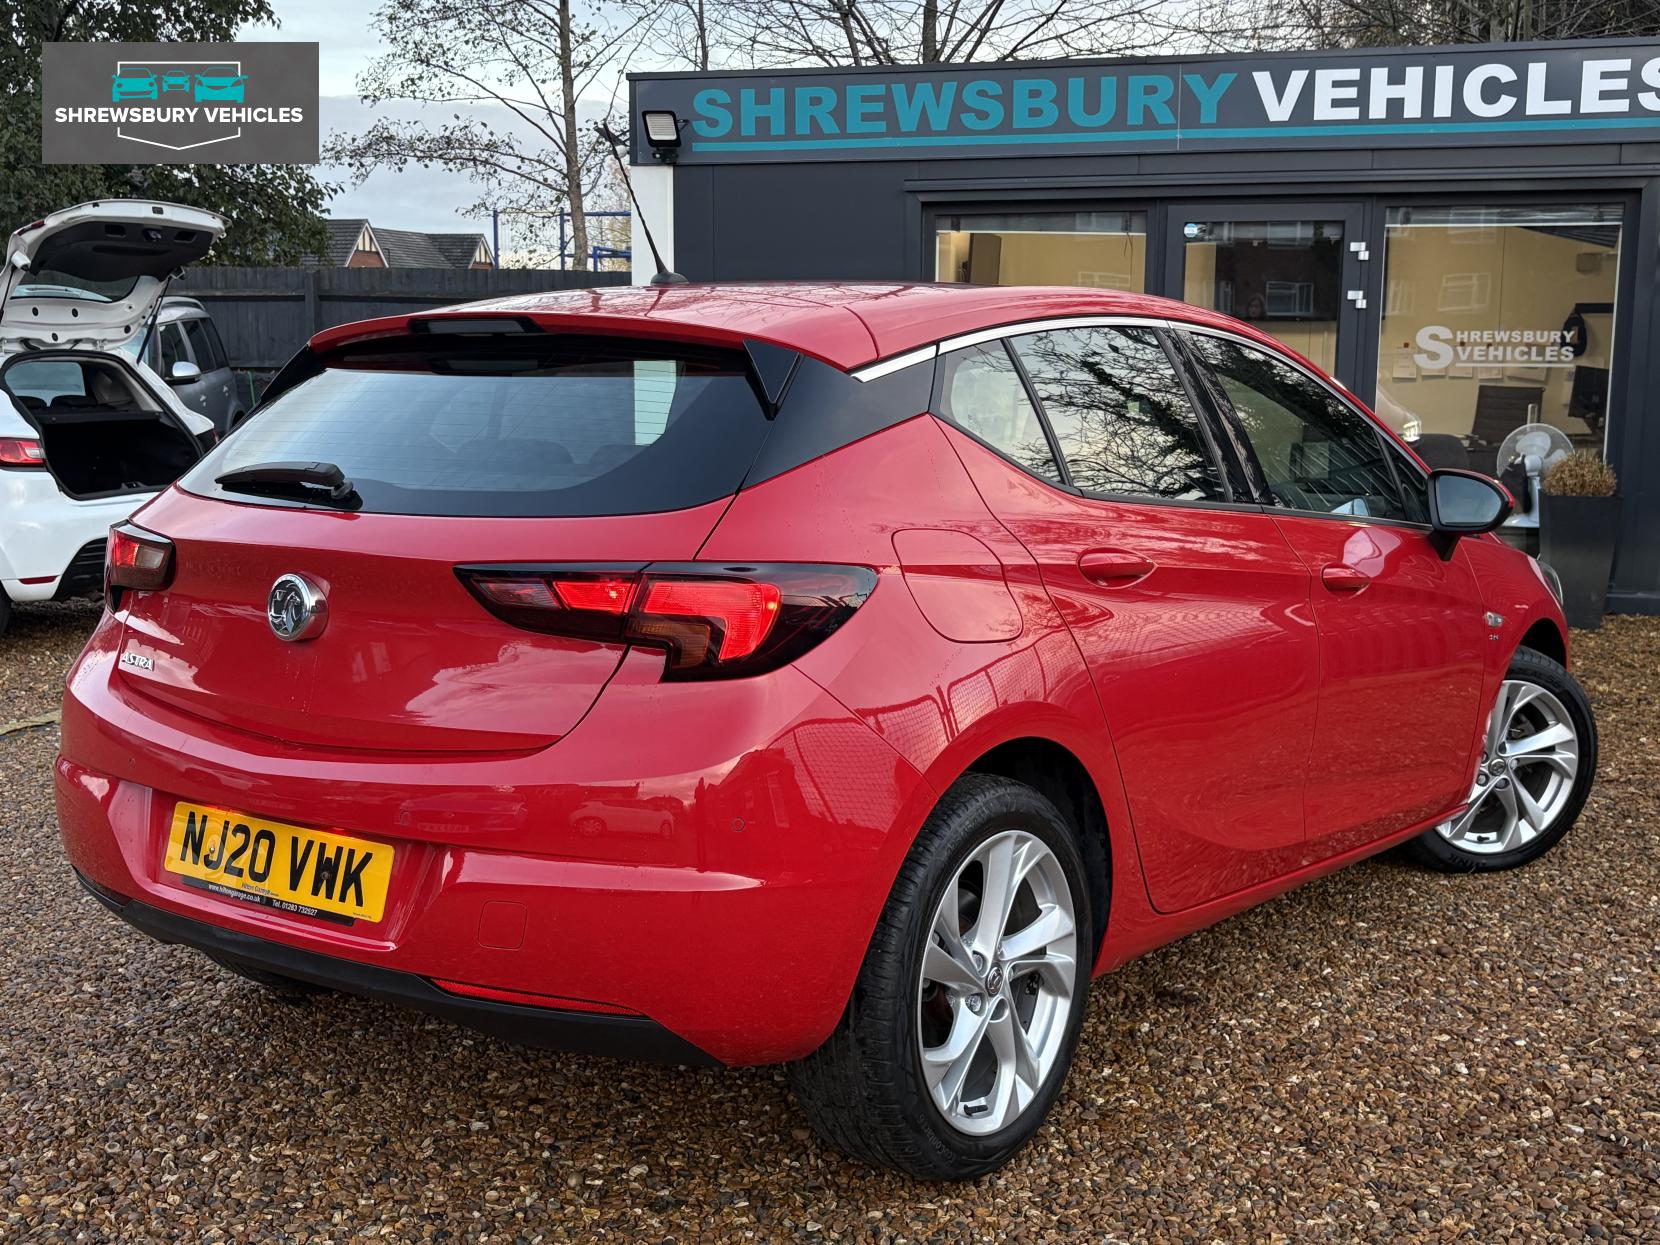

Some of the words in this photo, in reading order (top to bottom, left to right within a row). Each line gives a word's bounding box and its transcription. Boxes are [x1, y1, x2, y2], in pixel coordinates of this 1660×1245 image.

[692, 72, 1237, 138] SHREWSBURY
[1413, 325, 1575, 370] SHREWSBURY
[1456, 346, 1575, 362] VEHICLES
[121, 651, 154, 671] ASTRA
[179, 811, 276, 883] NJ20
[289, 836, 373, 907] VWK
